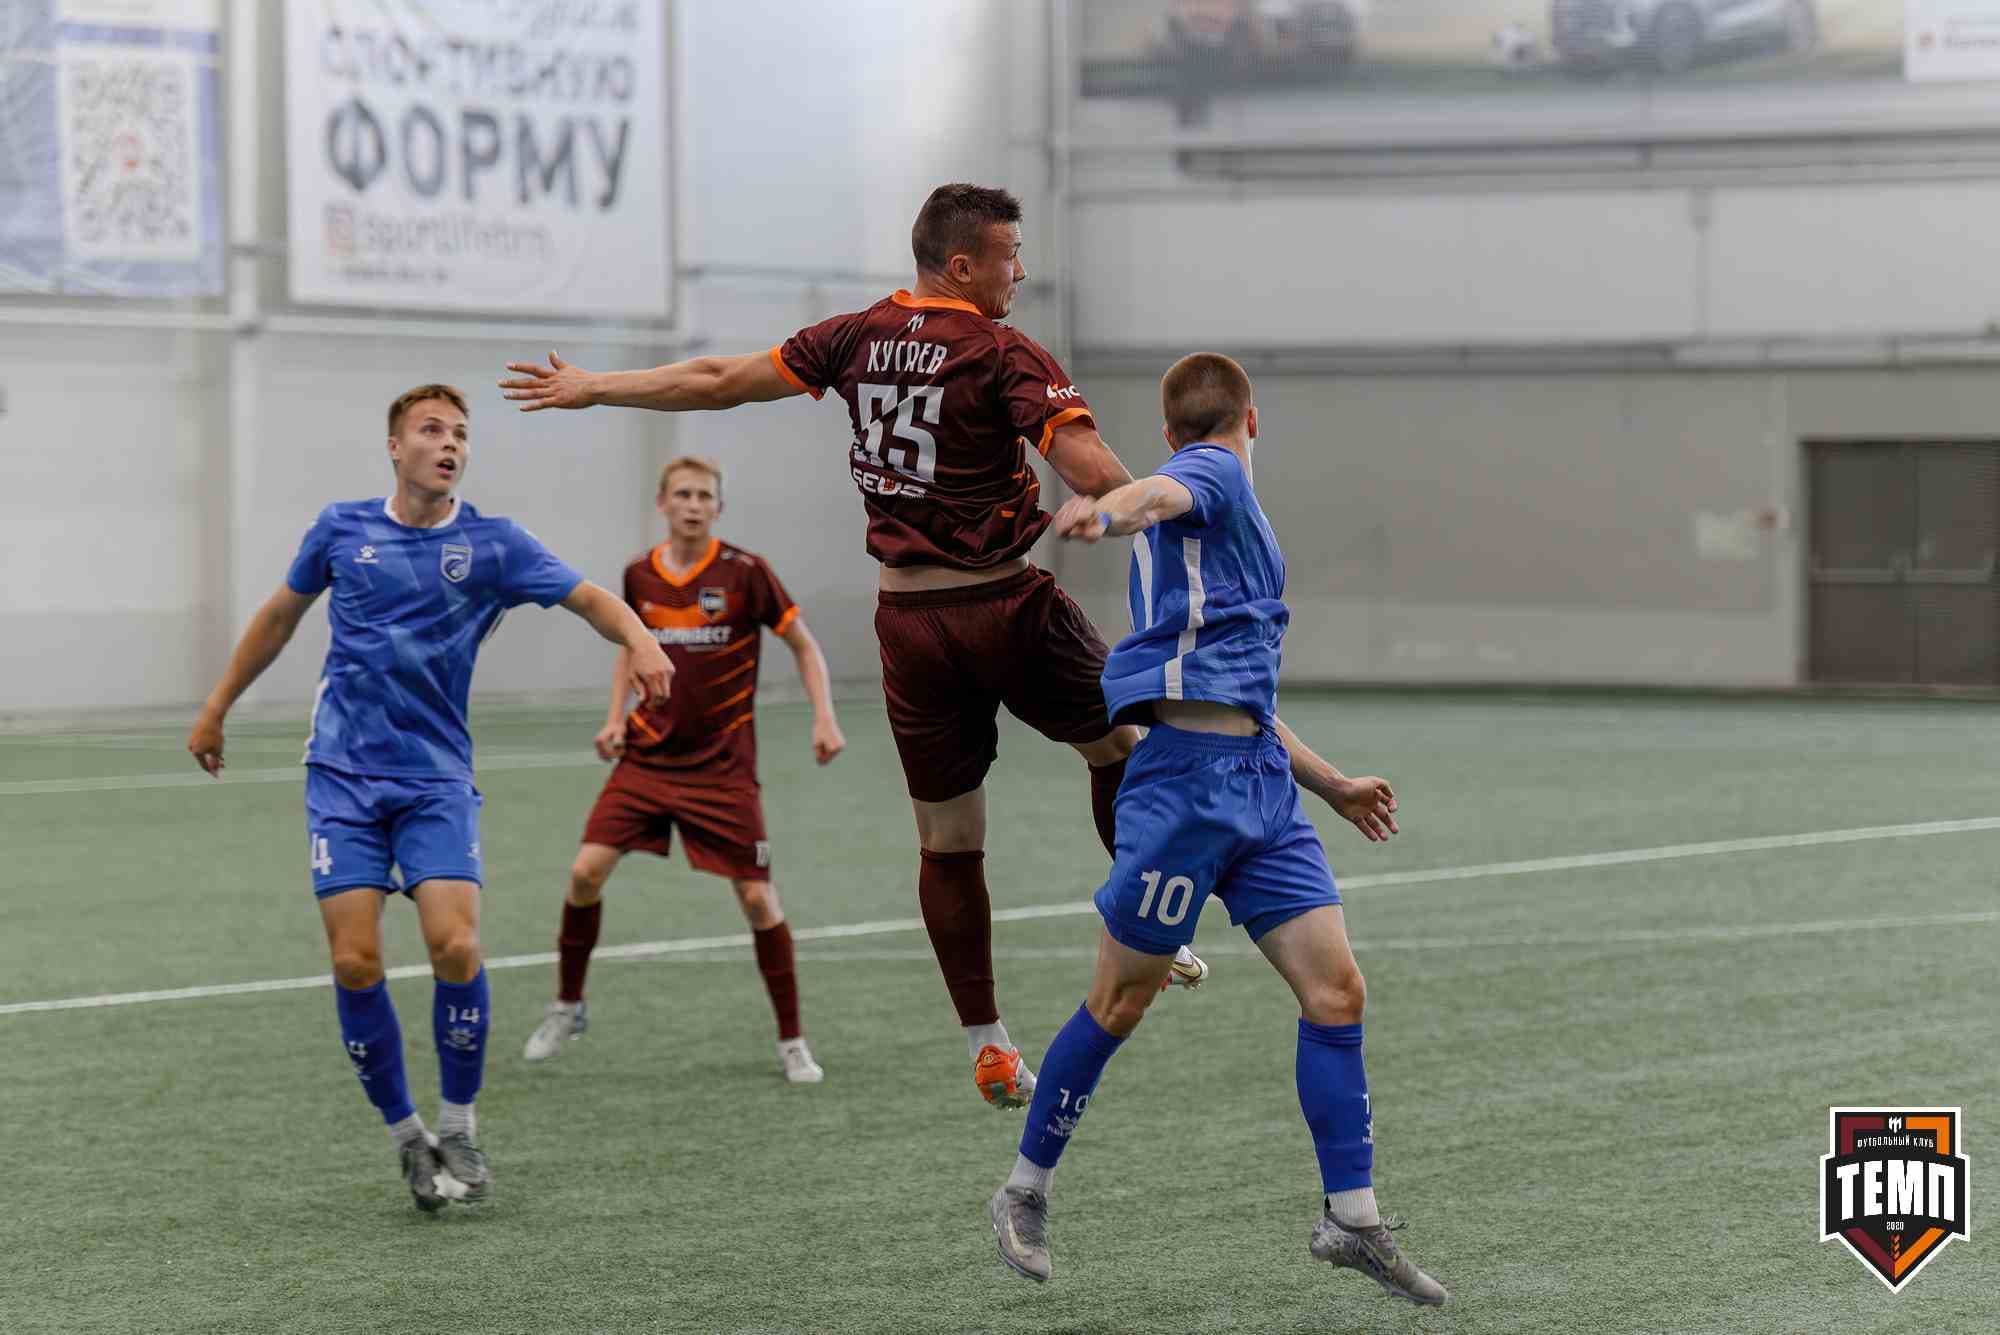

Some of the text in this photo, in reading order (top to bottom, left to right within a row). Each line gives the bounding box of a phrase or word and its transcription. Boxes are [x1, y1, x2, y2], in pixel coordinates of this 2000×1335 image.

[326, 98, 630, 210] ФОРМУ
[854, 383, 944, 483] 55
[1137, 869, 1194, 926] 10
[447, 1005, 480, 1024] 14
[1060, 1087, 1089, 1113] 10
